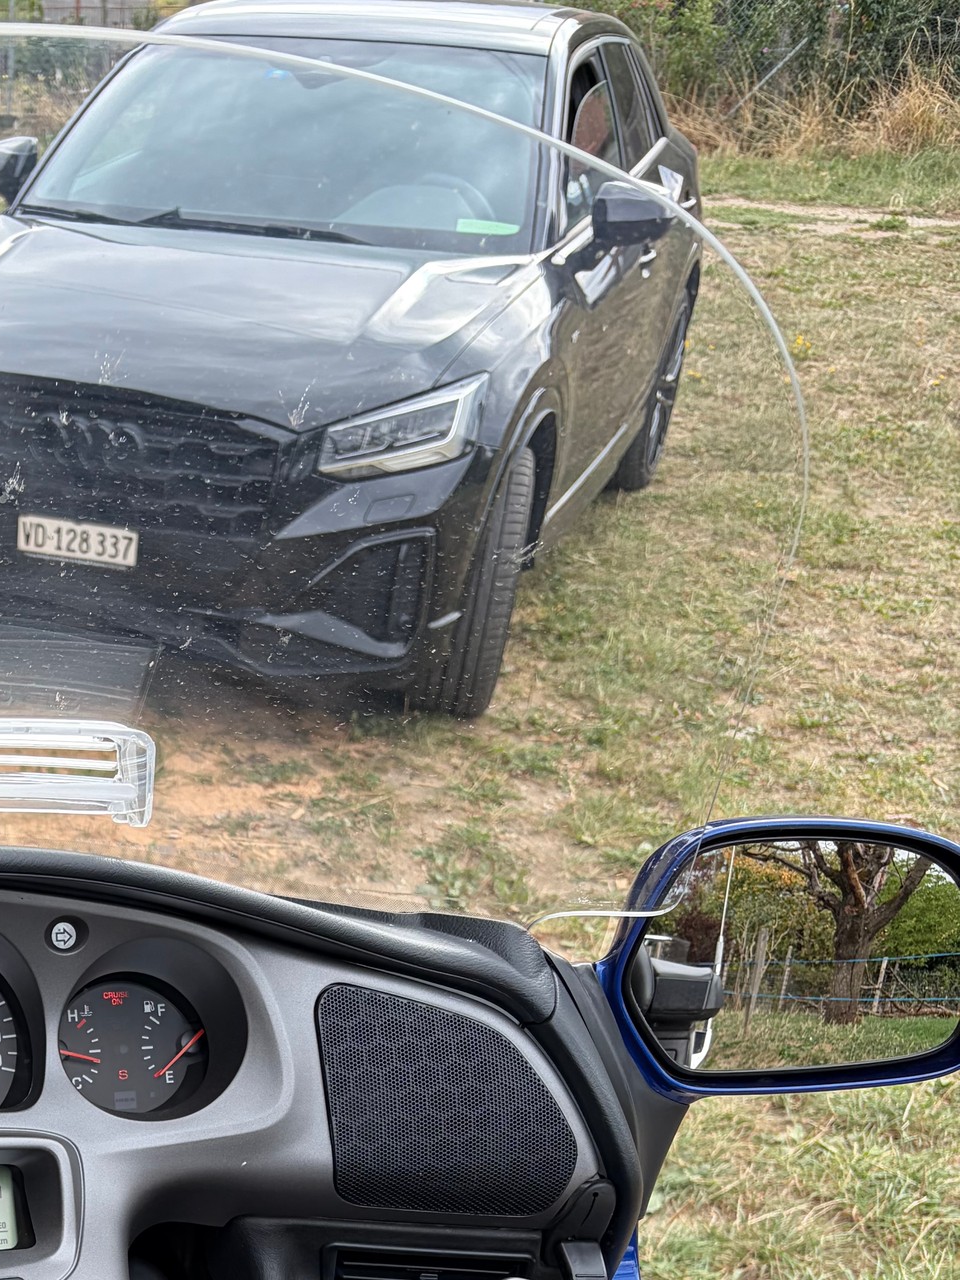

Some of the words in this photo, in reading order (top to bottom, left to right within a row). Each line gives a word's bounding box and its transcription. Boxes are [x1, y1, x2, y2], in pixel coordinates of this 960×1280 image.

[67, 1010, 78, 1022] H
[158, 1004, 165, 1016] F
[165, 1071, 174, 1083] E
